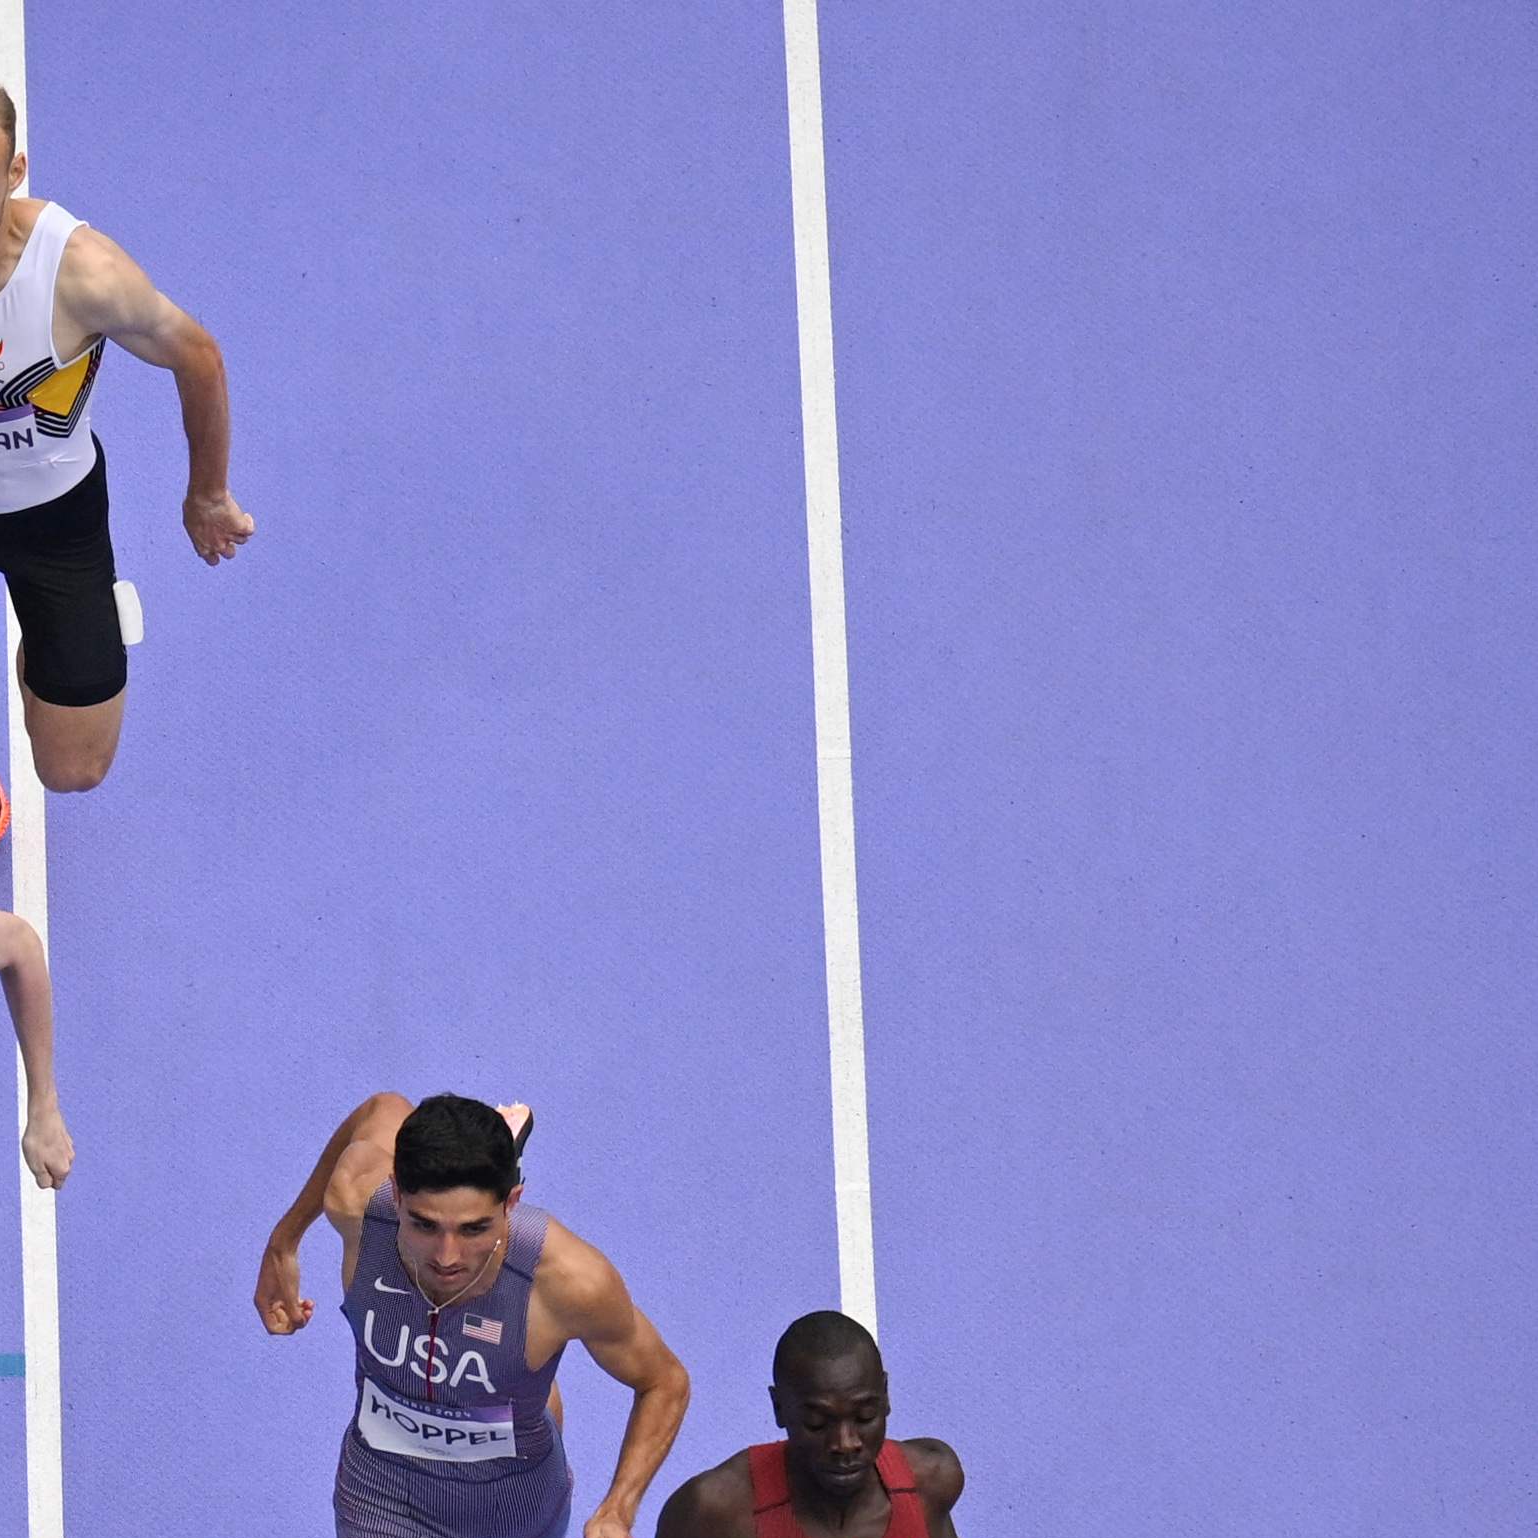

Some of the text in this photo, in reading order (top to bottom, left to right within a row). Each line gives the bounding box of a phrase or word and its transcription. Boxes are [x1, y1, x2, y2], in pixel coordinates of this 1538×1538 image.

[363, 1309, 497, 1394] USA
[371, 1395, 508, 1446] HOPPEL
[435, 1408, 472, 1418] 2024
